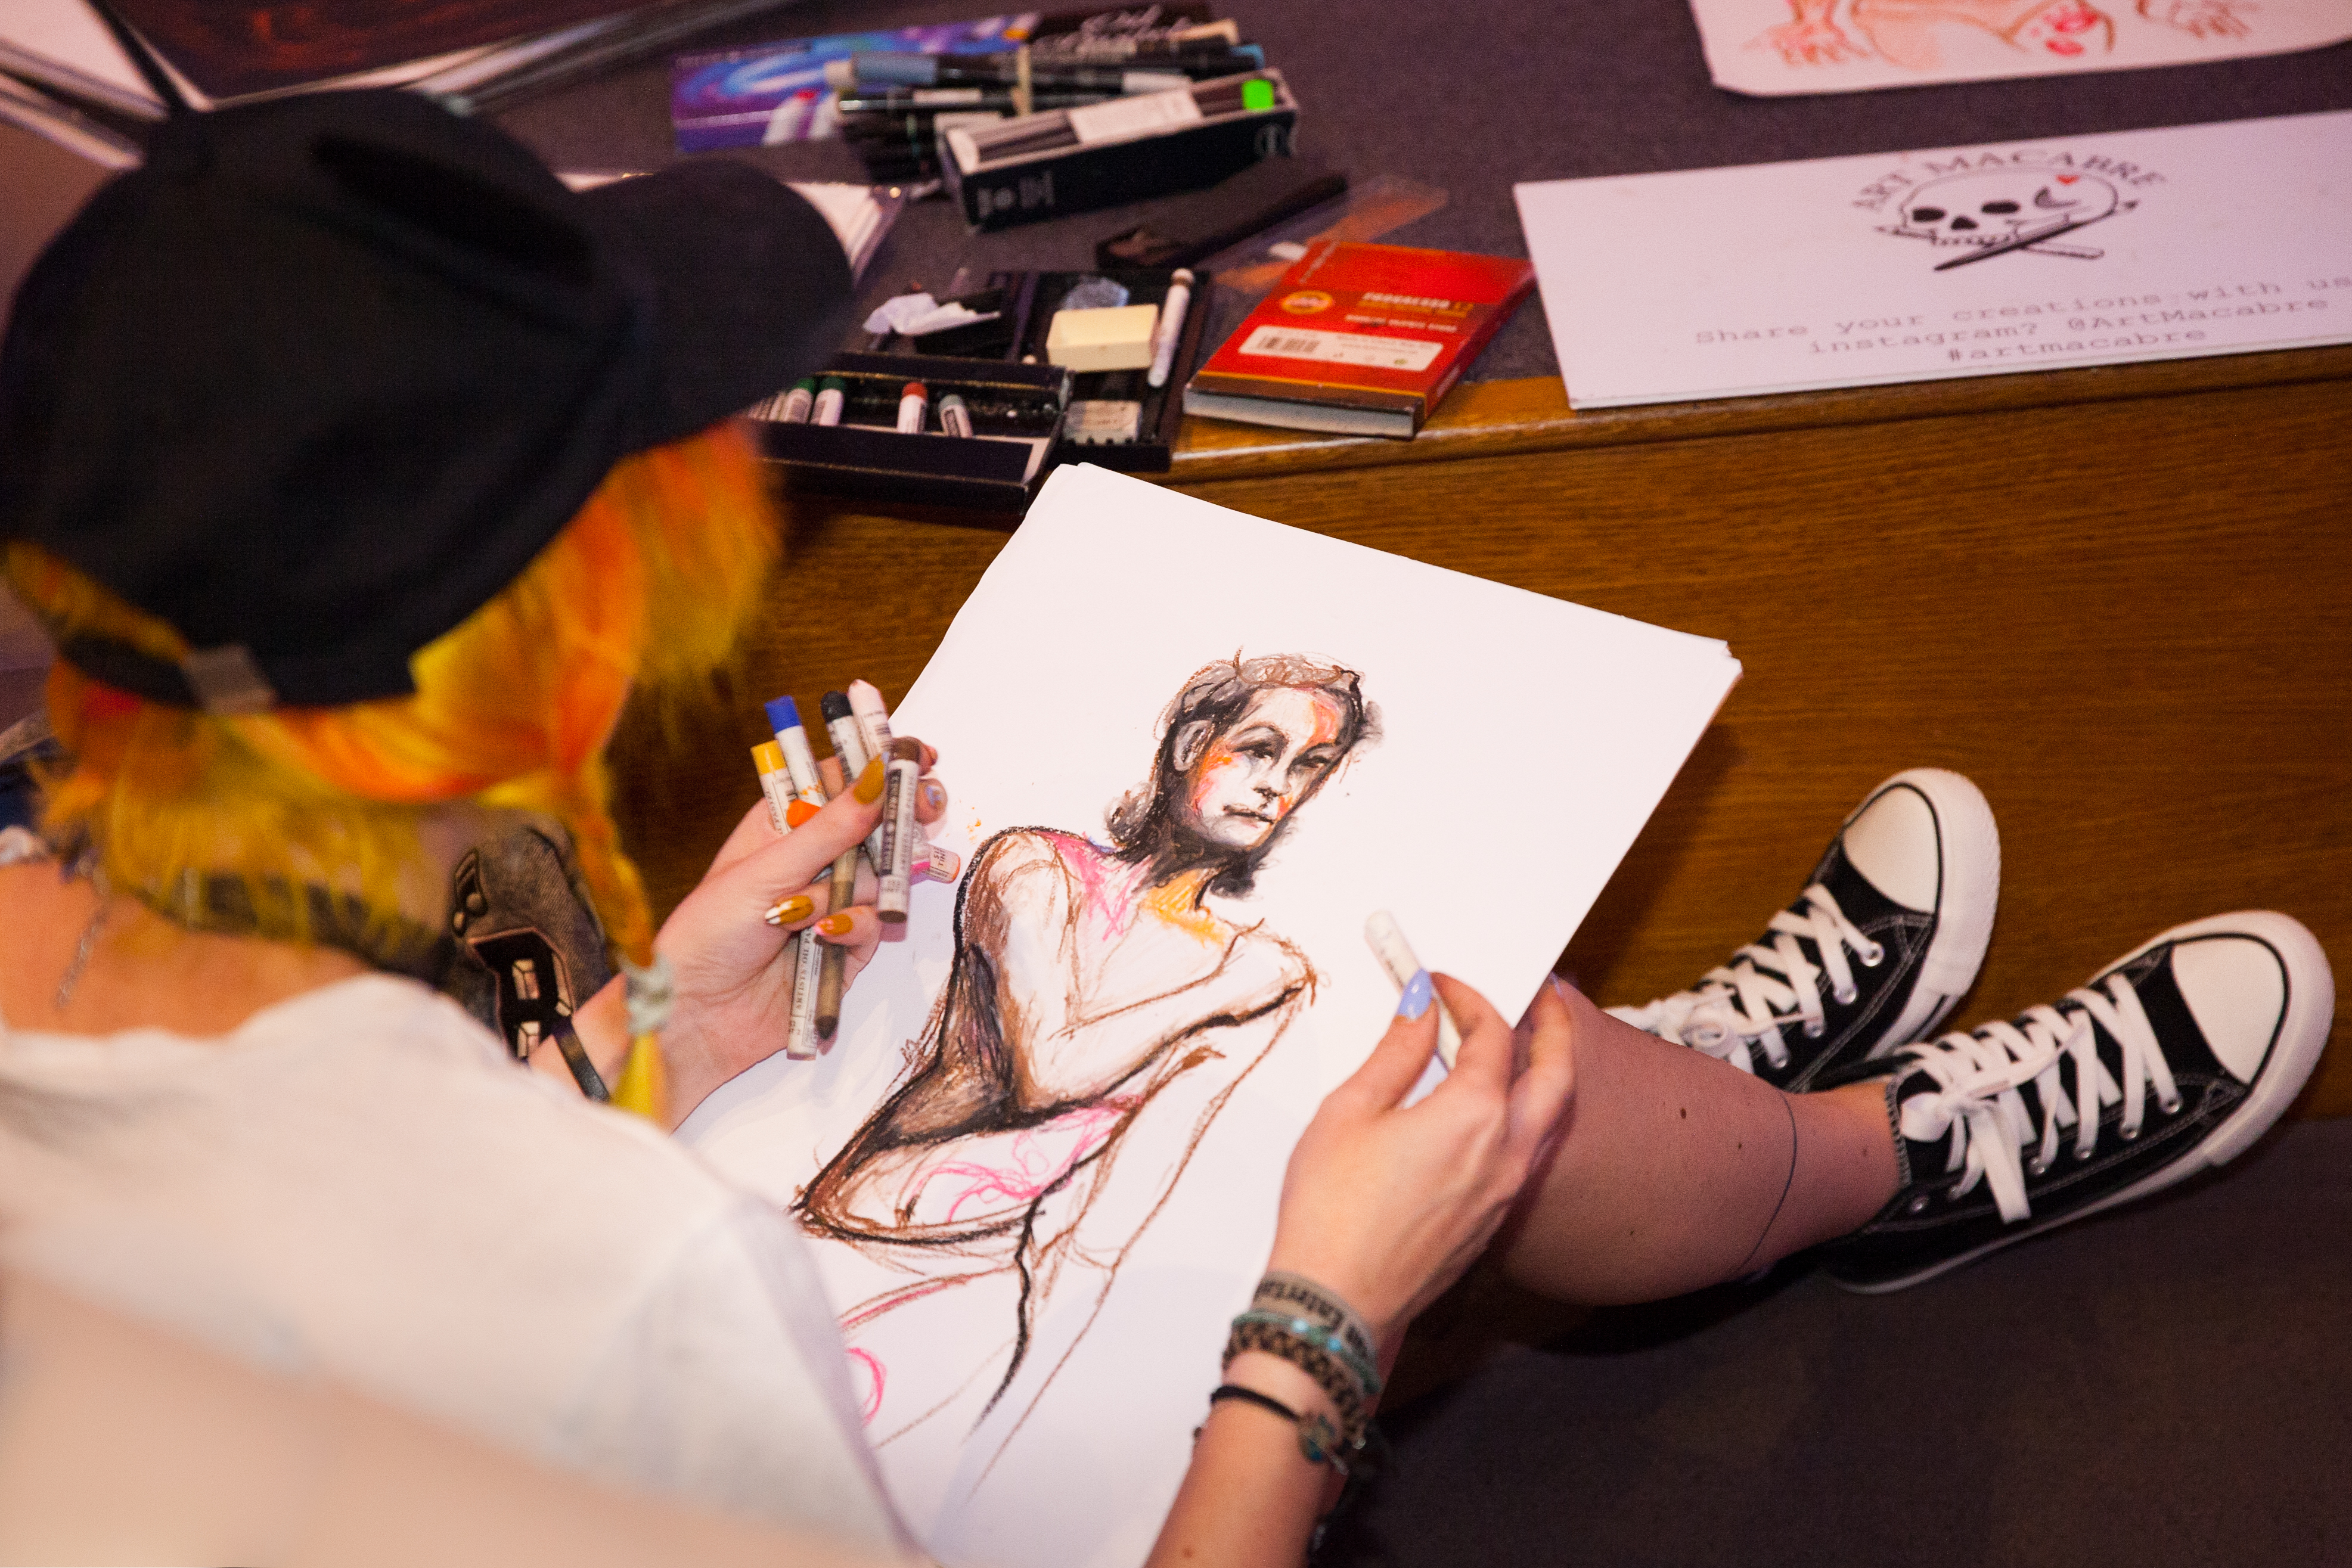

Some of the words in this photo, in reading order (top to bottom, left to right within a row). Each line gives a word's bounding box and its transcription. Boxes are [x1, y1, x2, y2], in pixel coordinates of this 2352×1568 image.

[1852, 169, 1913, 212] ART
[1924, 148, 2168, 186] MACABRE
[1696, 325, 1808, 344] Share
[1835, 314, 1924, 334] your
[1953, 297, 2161, 321] creations
[2187, 281, 2282, 300] with
[2307, 276, 2352, 291] us
[1811, 322, 2038, 353] instagram?
[2067, 299, 2329, 331] @ArtMacabre
[1948, 330, 2206, 361] #artmacabre
